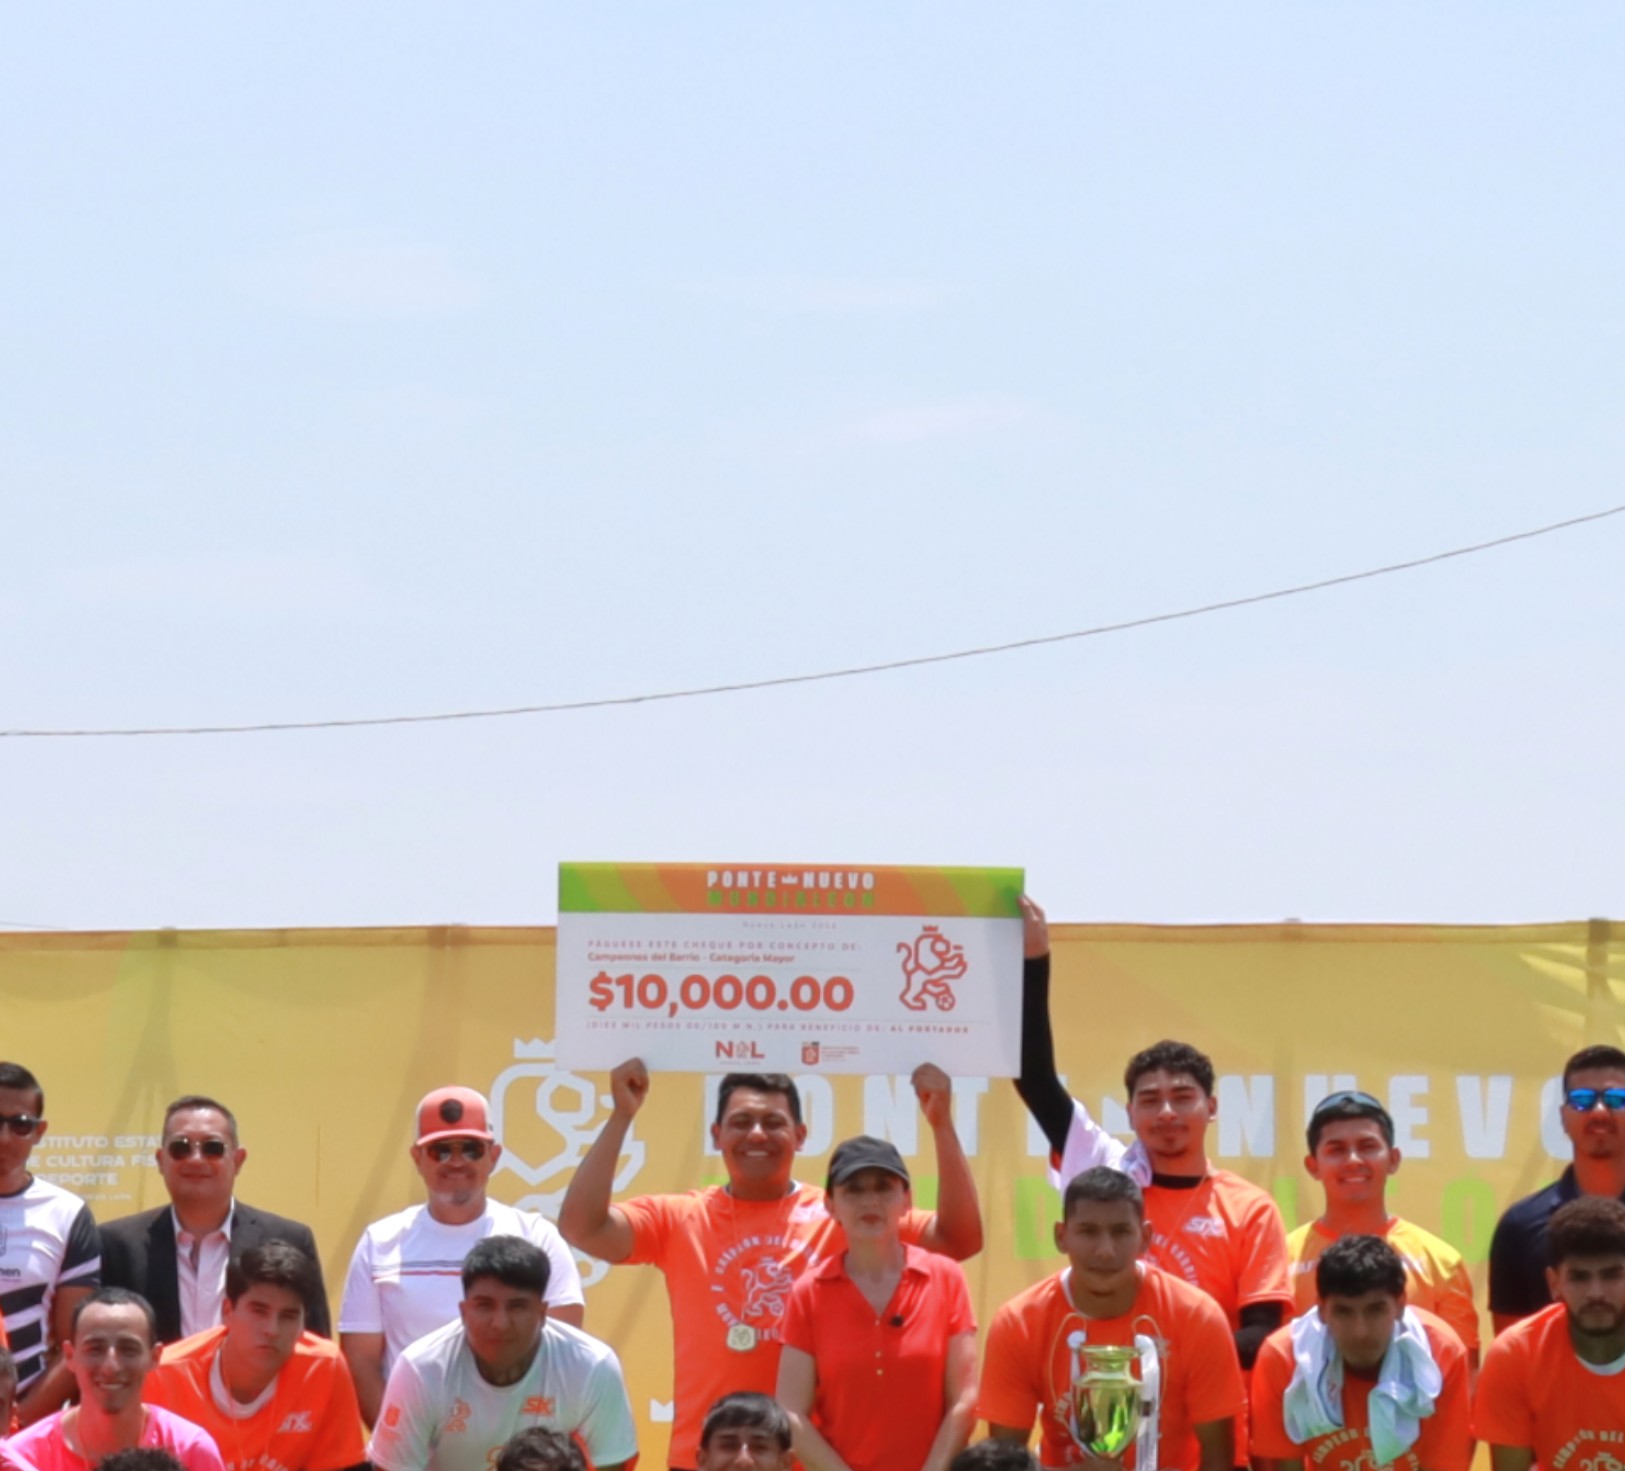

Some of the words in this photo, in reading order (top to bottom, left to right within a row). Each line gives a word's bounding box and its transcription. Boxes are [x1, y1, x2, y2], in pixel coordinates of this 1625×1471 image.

[707, 871, 776, 888] PONTE
[803, 872, 873, 889] NUEVO
[587, 970, 854, 1020] $10,000.00
[46, 1154, 125, 1168] CULTURA
